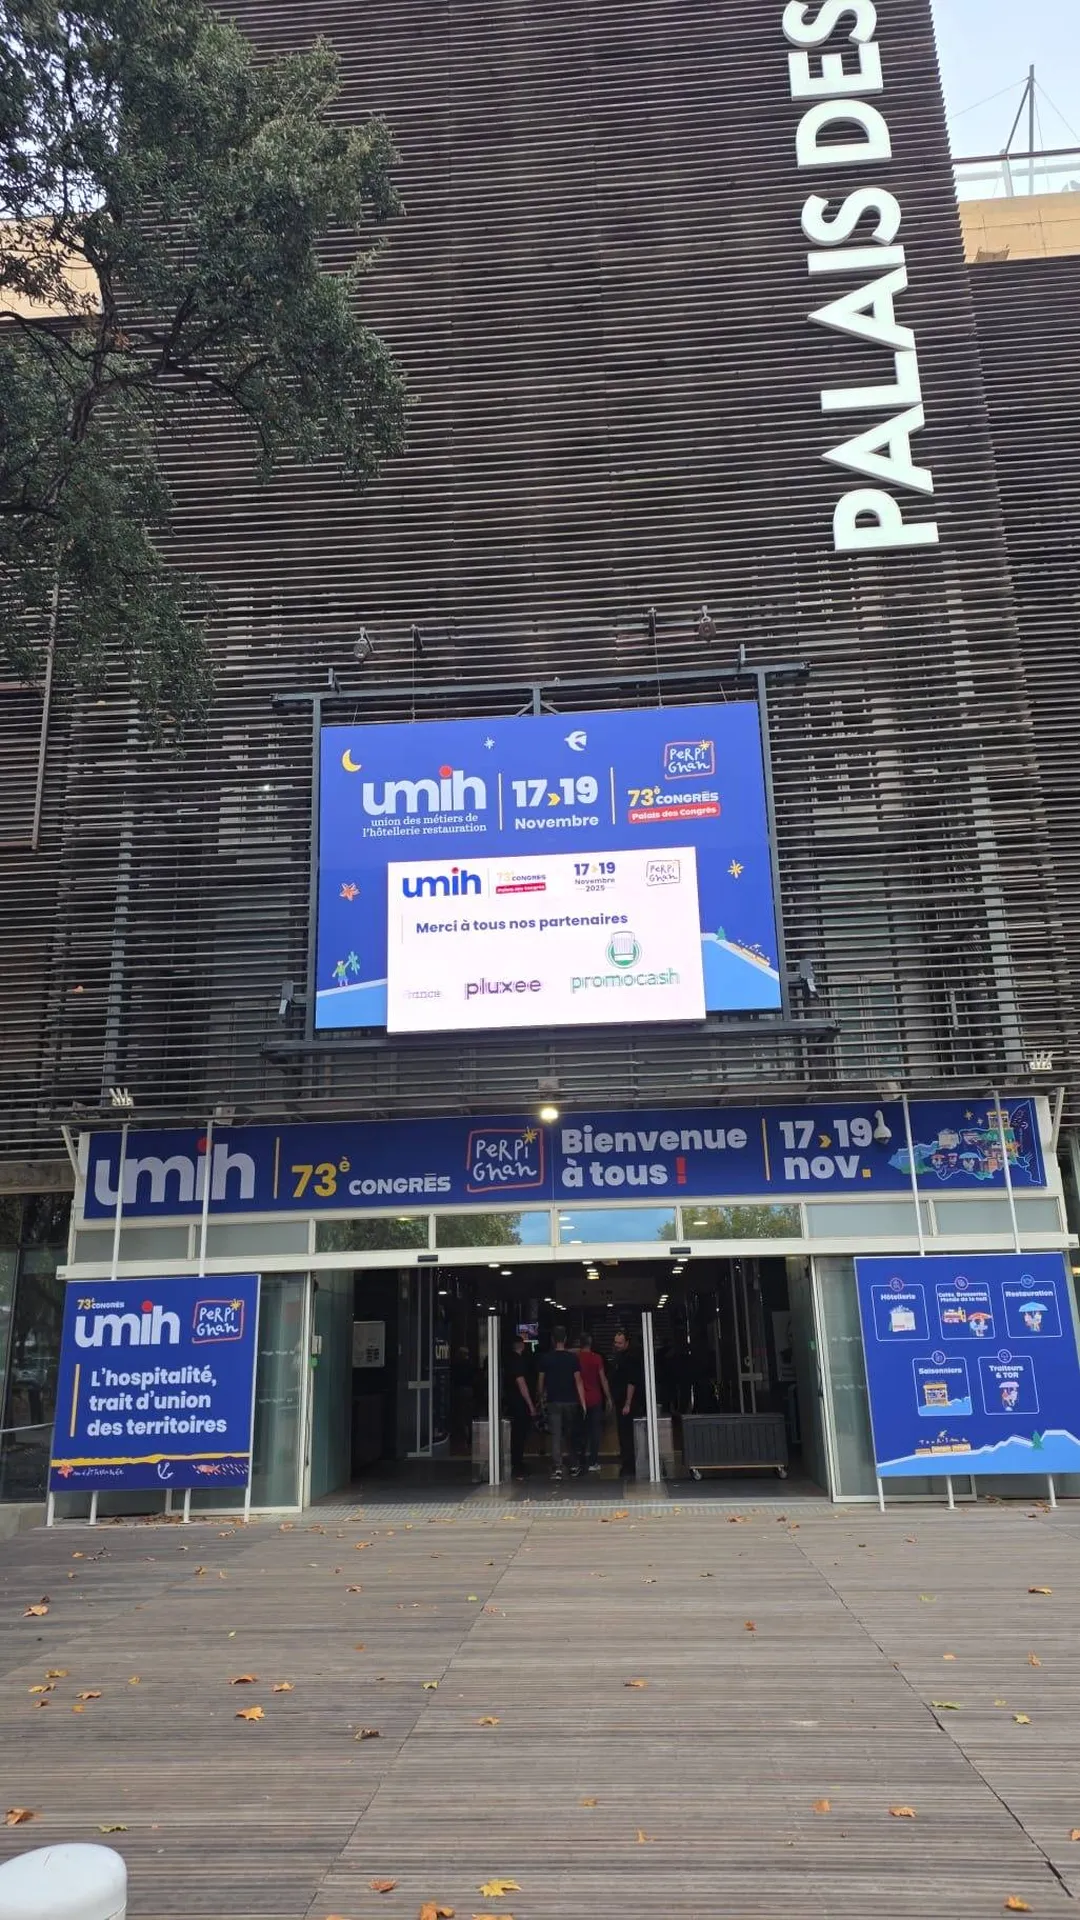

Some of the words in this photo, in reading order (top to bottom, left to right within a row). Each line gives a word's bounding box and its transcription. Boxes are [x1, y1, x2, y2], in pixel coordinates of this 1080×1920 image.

[782, 0, 892, 169] DES
[802, 187, 940, 551] PALAIS
[363, 765, 487, 816] umih
[512, 779, 548, 808] 17
[560, 776, 599, 805] 19
[371, 816, 401, 827] union
[403, 815, 421, 826] des
[423, 814, 463, 825] métiers
[465, 813, 478, 823] de
[514, 814, 599, 830] Novembre
[631, 811, 660, 821] Palais
[662, 809, 679, 818] des
[422, 823, 487, 835] restauration
[574, 863, 590, 876] 17
[599, 862, 616, 874] 19
[574, 877, 616, 886] Novembre
[402, 867, 482, 898] umih
[416, 920, 458, 934] Merci
[460, 920, 470, 931] à
[474, 920, 506, 931] tous
[509, 918, 536, 929] nos
[539, 914, 629, 932] partenaires
[465, 977, 542, 1000] pluxee
[570, 968, 681, 993] promocash
[561, 1125, 748, 1154] Bienvenue
[779, 1120, 815, 1150] 17
[833, 1117, 873, 1147] 19
[94, 1137, 255, 1206] umih
[561, 1158, 584, 1188] à
[590, 1160, 669, 1186] tous
[783, 1155, 872, 1180] nov.
[75, 1300, 181, 1348] umih
[91, 1365, 218, 1390] L'hospitalité,
[89, 1392, 133, 1412] trait
[136, 1390, 211, 1410] d'union
[87, 1419, 123, 1436] des
[126, 1415, 228, 1436] territoires
